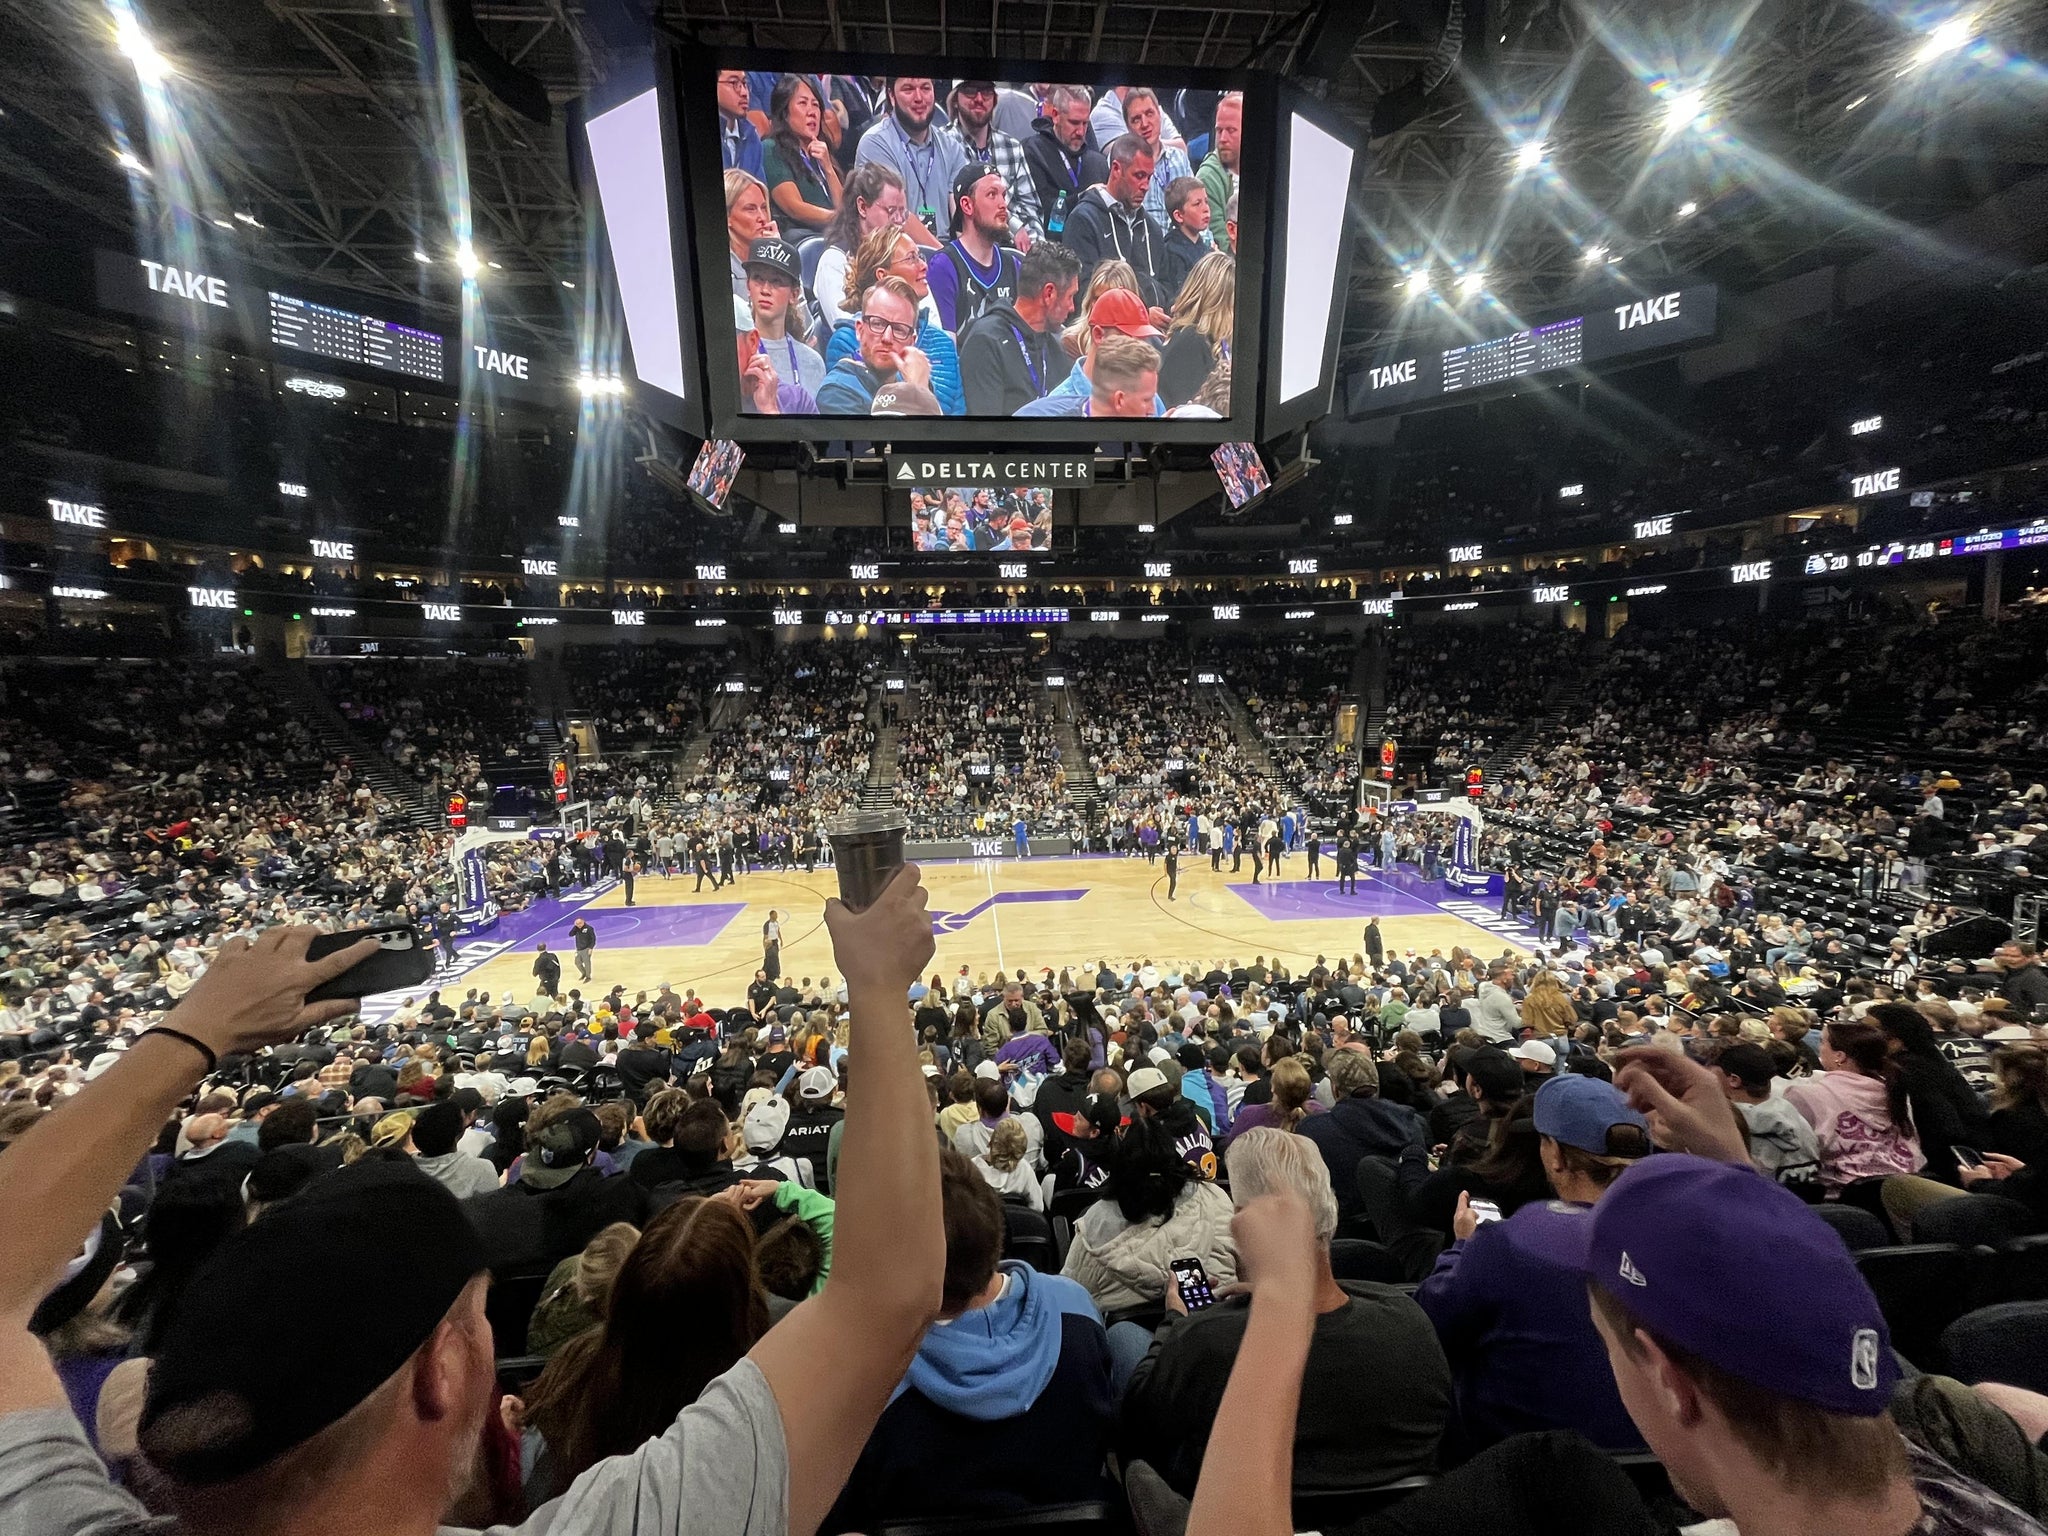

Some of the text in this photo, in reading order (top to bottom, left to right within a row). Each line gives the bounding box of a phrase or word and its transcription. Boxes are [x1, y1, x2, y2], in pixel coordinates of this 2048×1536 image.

[141, 257, 228, 308] TAKE
[1615, 292, 1680, 330] TAKE
[371, 318, 387, 328] JAZZ
[474, 345, 529, 380] TAKE
[1369, 358, 1417, 390] TAKE
[1850, 415, 1882, 436] TAKE
[921, 463, 1088, 479] DELTA CENTER
[278, 481, 308, 498] TAKE
[1850, 467, 1901, 498] TAKE
[1559, 484, 1584, 498] TAKE
[48, 499, 105, 528] TAKE
[557, 515, 579, 527] TAKE
[1333, 514, 1353, 526] TAKE
[778, 523, 797, 534] TAKE
[1633, 517, 1673, 539] TAKE
[309, 539, 355, 561] TAKE
[1448, 545, 1483, 563] TAKE
[1907, 542, 1934, 560] 7:48
[1287, 558, 1318, 574] TAKE
[1830, 555, 1848, 570] 20
[1856, 551, 1873, 567] 10
[520, 559, 558, 576] TAKE
[694, 565, 727, 580] TAKE
[850, 564, 879, 579] TAKE
[998, 563, 1028, 578] TAKE
[1143, 562, 1172, 577] TAKE
[1730, 560, 1772, 584] TAKE
[187, 586, 238, 609] TAKE
[1532, 582, 1569, 603] TAKE
[420, 603, 461, 621] TAKE
[1212, 603, 1240, 620] TAKE
[1362, 599, 1394, 616] TAKE
[611, 610, 646, 626] TAKE
[772, 610, 803, 625] TAKE
[841, 613, 853, 624] 20
[857, 613, 868, 624] 10
[885, 679, 905, 690] TAKE
[1046, 676, 1065, 686] TAKE
[1197, 673, 1215, 684] TAKE
[725, 682, 744, 692] TAKE
[970, 764, 991, 776] TAKE
[1164, 758, 1184, 771] TAKE
[770, 770, 790, 781] TAKE
[1426, 792, 1442, 801] TAKE
[497, 819, 516, 829] TAKE
[971, 841, 1003, 856] TAKE
[467, 858, 475, 876] FIRST
[1437, 900, 1530, 931] UTAH
